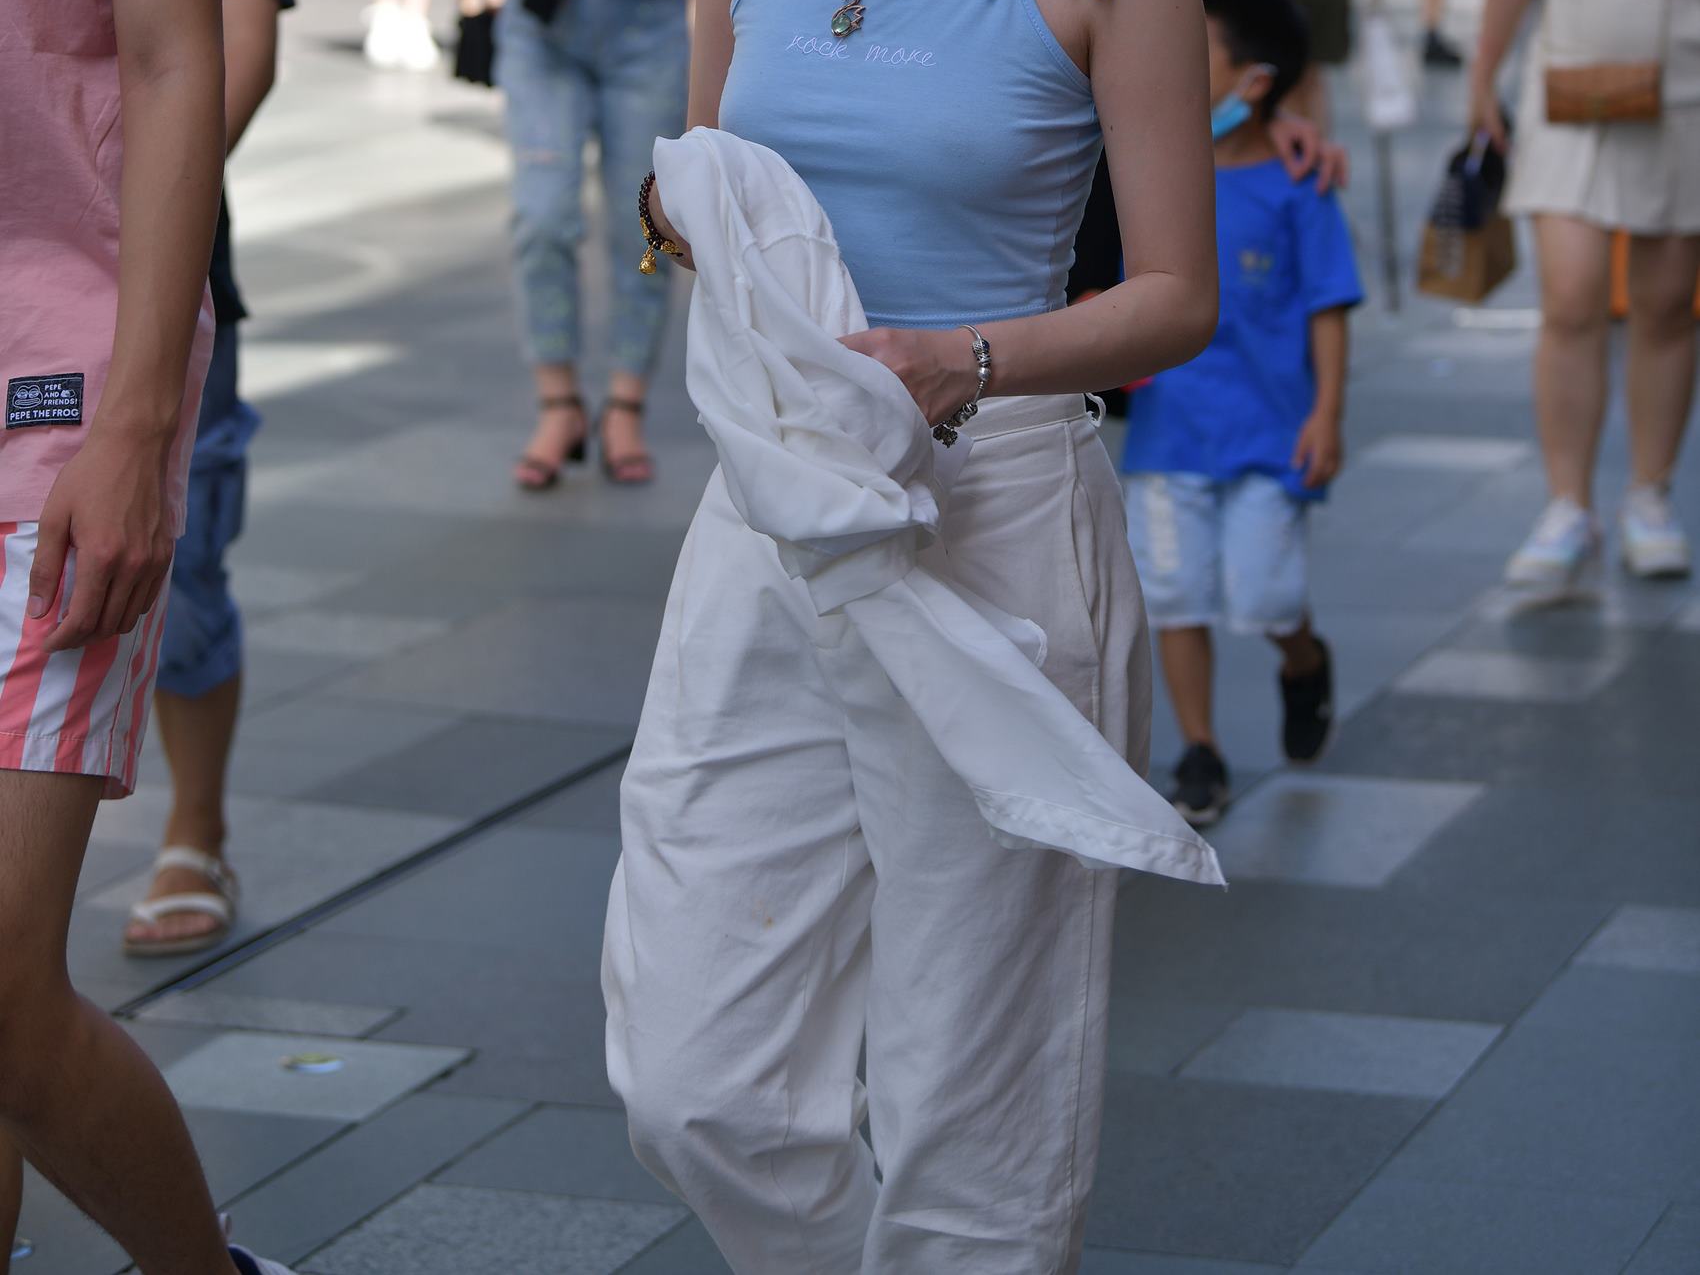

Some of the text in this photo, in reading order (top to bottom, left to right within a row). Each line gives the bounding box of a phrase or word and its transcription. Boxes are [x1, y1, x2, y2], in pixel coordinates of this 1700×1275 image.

[44, 383, 62, 391] PEPE
[43, 398, 78, 406] FRIENDS!
[10, 408, 79, 421] PEPE THE FROG
